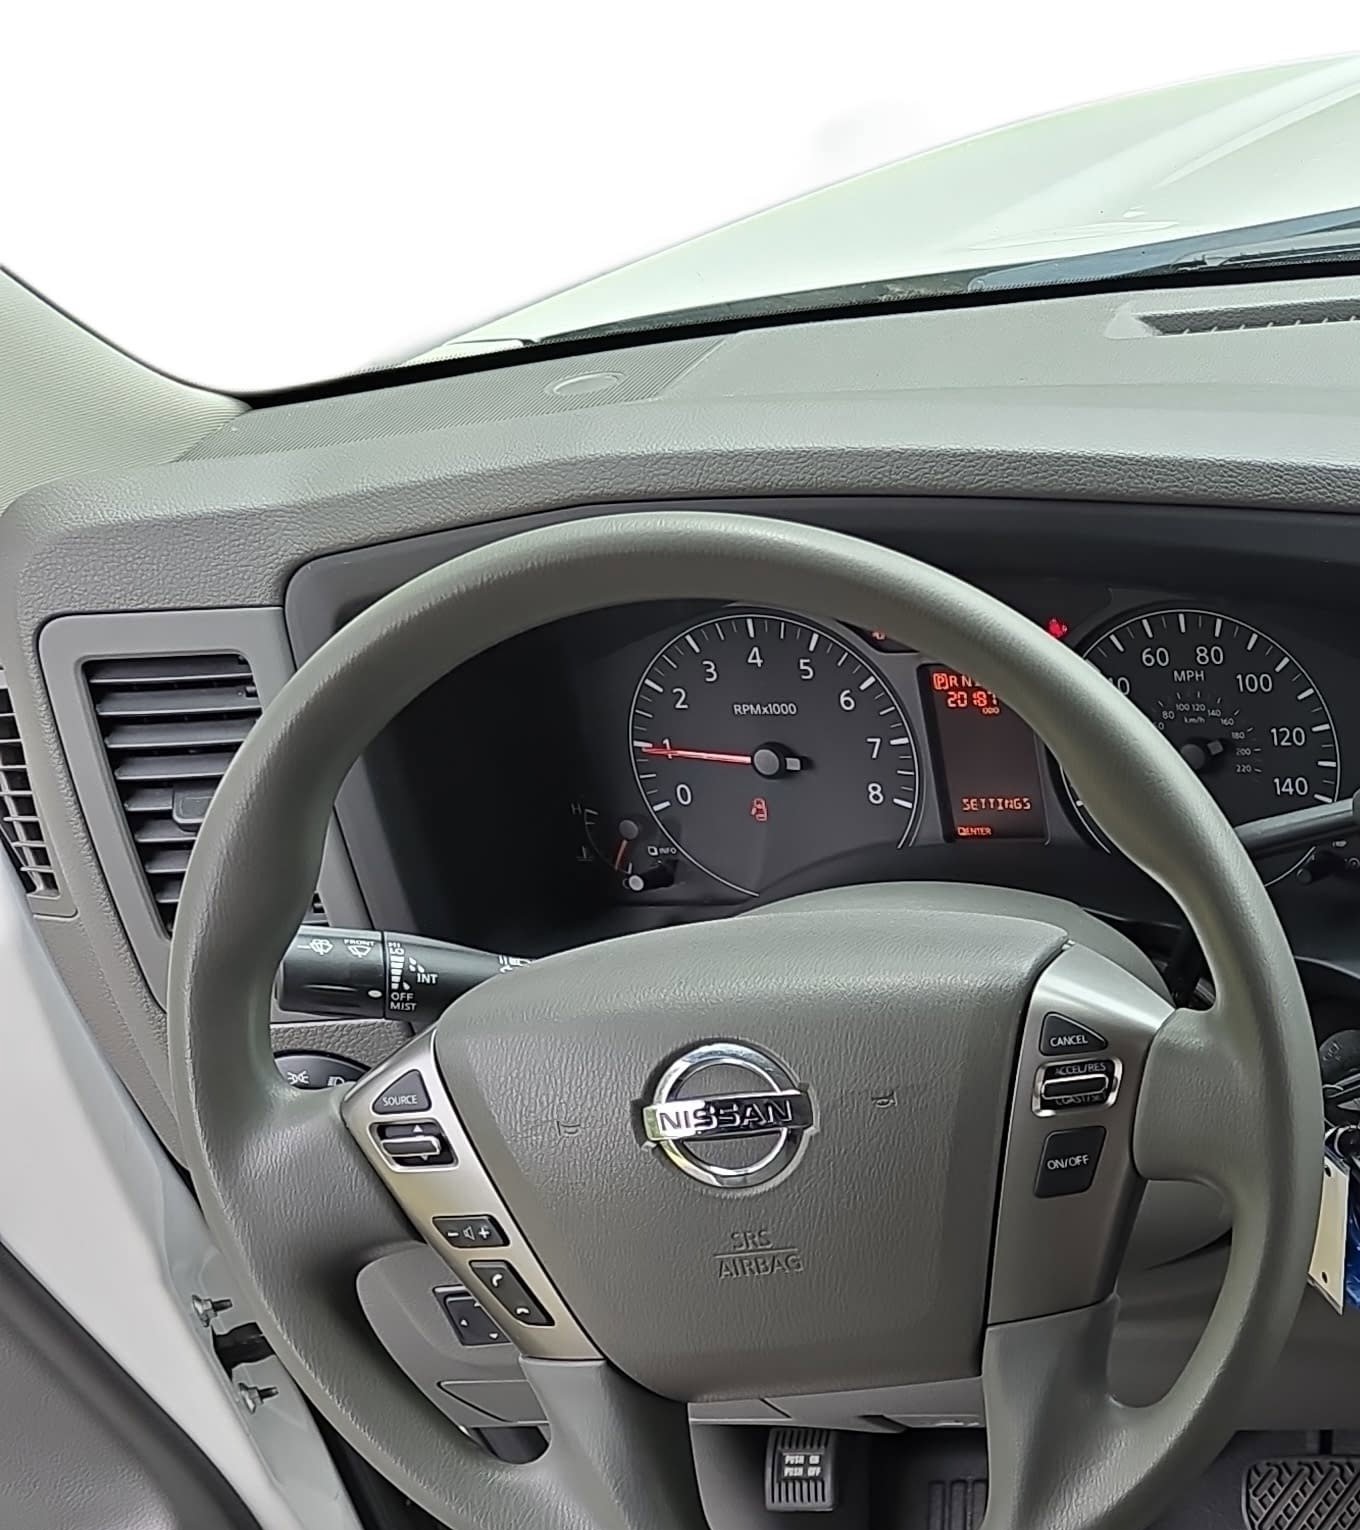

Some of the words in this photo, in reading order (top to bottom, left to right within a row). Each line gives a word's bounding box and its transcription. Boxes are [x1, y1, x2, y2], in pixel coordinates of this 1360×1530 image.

[747, 647, 763, 668] 4
[1141, 647, 1170, 667] 60
[1195, 646, 1224, 666] 80
[702, 660, 718, 682] 3
[799, 659, 815, 680] 5
[1173, 670, 1205, 683] MPH
[949, 674, 957, 687] R
[961, 676, 972, 687] N
[1235, 673, 1273, 693] 100
[672, 688, 688, 709] 2
[839, 690, 855, 711] 6
[733, 703, 797, 716] RPMx1000
[1175, 702, 1190, 712] 100
[1191, 702, 1206, 712] 120
[1207, 707, 1222, 718] 140
[1162, 710, 1175, 720] 80
[1220, 717, 1234, 727] 160
[1231, 730, 1245, 740] 180
[1270, 727, 1306, 746] 120
[662, 738, 672, 759] 1
[866, 738, 881, 759] 7
[1235, 747, 1251, 756] 200
[1235, 764, 1252, 773] 220
[867, 783, 884, 805] 8
[1273, 777, 1309, 796] 140
[676, 784, 692, 805] 0
[962, 797, 1032, 811] SETTINGS
[659, 847, 677, 855] INFO
[416, 973, 438, 984] INT
[391, 992, 414, 1001] OFF
[390, 1001, 416, 1011] MIST
[1050, 1034, 1088, 1047] CANCEL
[1055, 1061, 1107, 1076] ACCEL/RES
[382, 1094, 418, 1107] SOURCE
[659, 1099, 793, 1131] NISSAN
[1047, 1154, 1089, 1170] ON/OFF
[731, 1228, 773, 1250] SRS
[718, 1253, 804, 1279] AIRBAG
